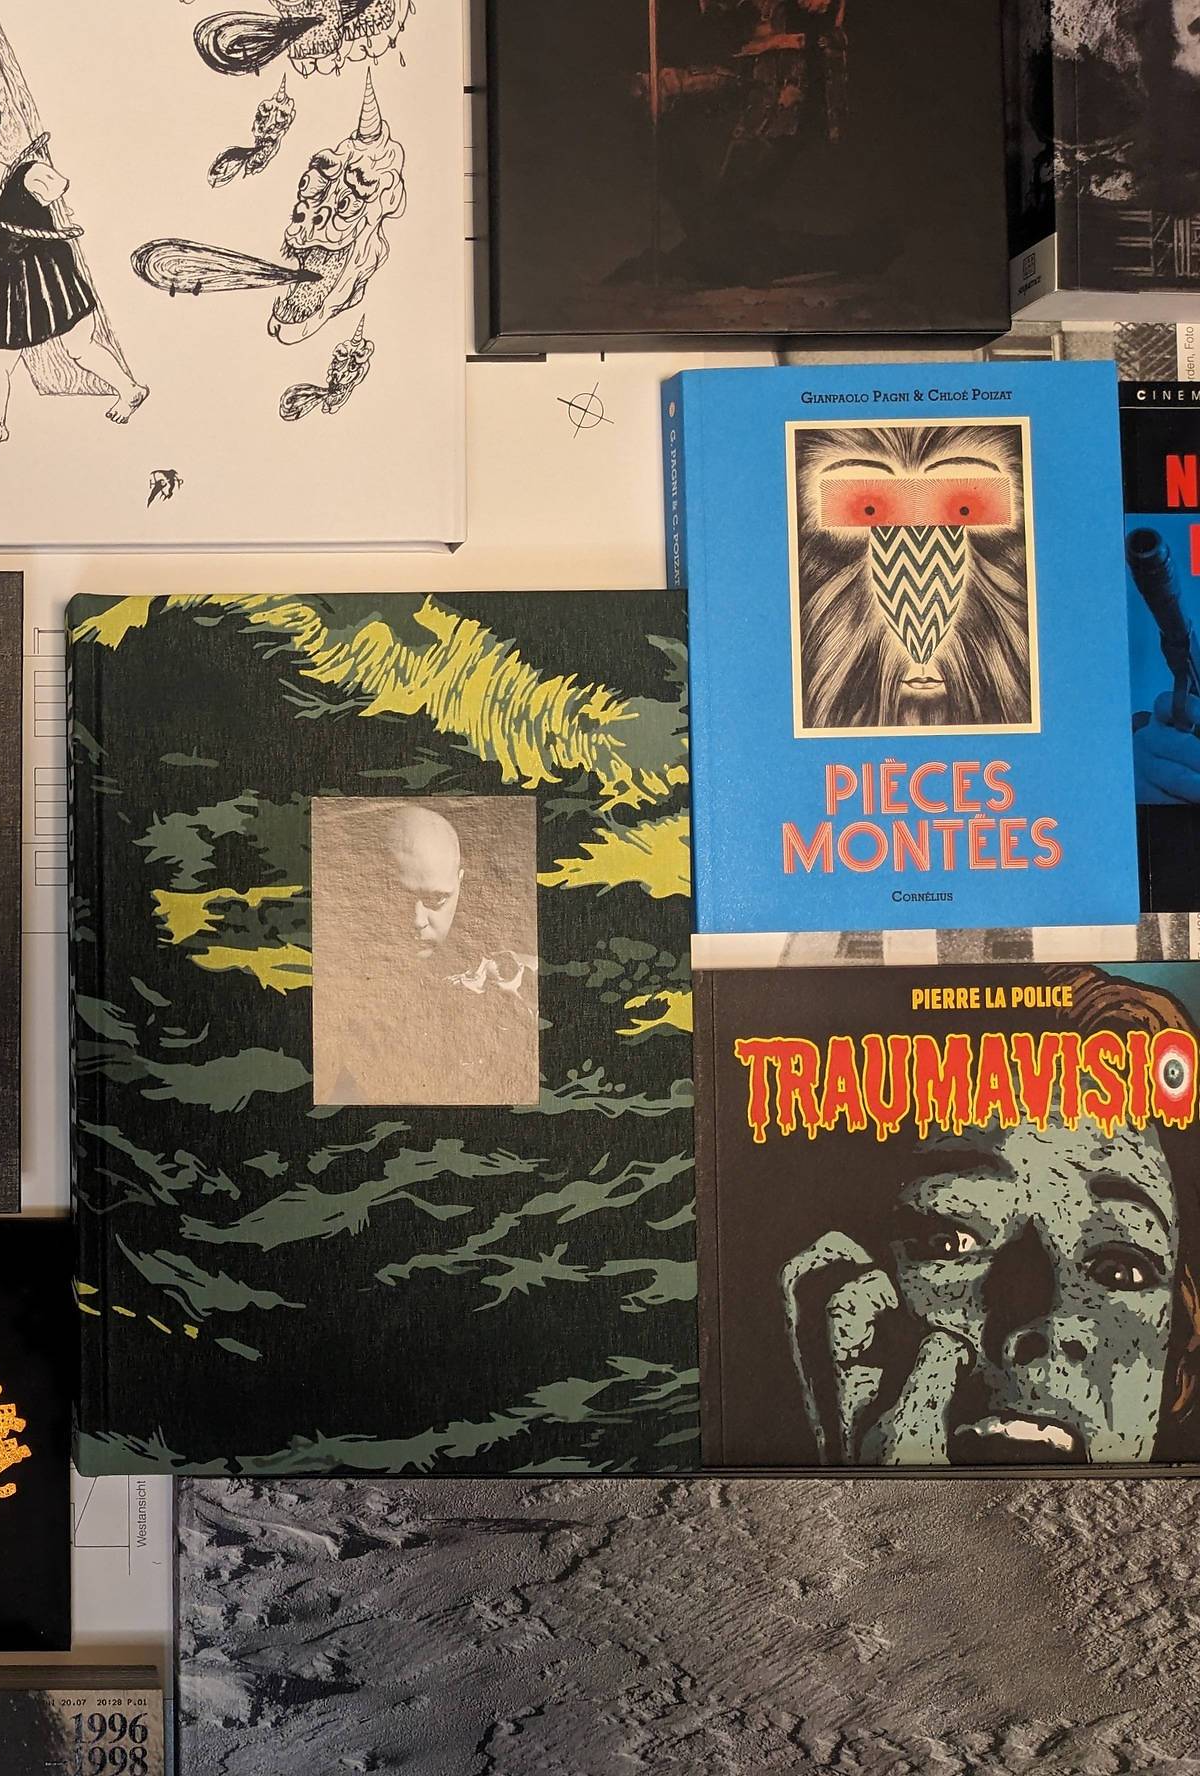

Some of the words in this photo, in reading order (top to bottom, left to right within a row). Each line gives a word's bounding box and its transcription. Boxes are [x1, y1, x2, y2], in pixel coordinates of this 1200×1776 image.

[1184, 326, 1194, 350] Foto
[913, 389, 924, 402] &
[781, 814, 1064, 874] MONTÉES
[911, 986, 981, 1010] PIERRE
[984, 986, 1007, 1009] LA
[1011, 985, 1073, 1008] POLICE
[733, 1027, 1200, 1144] TRAUMAVISIO
[135, 1480, 147, 1548] Westansicht
[61, 1698, 87, 1706] 20.07
[96, 1698, 123, 1706] 20:28
[70, 1712, 149, 1745] 1996
[71, 1746, 149, 1776] 1998
